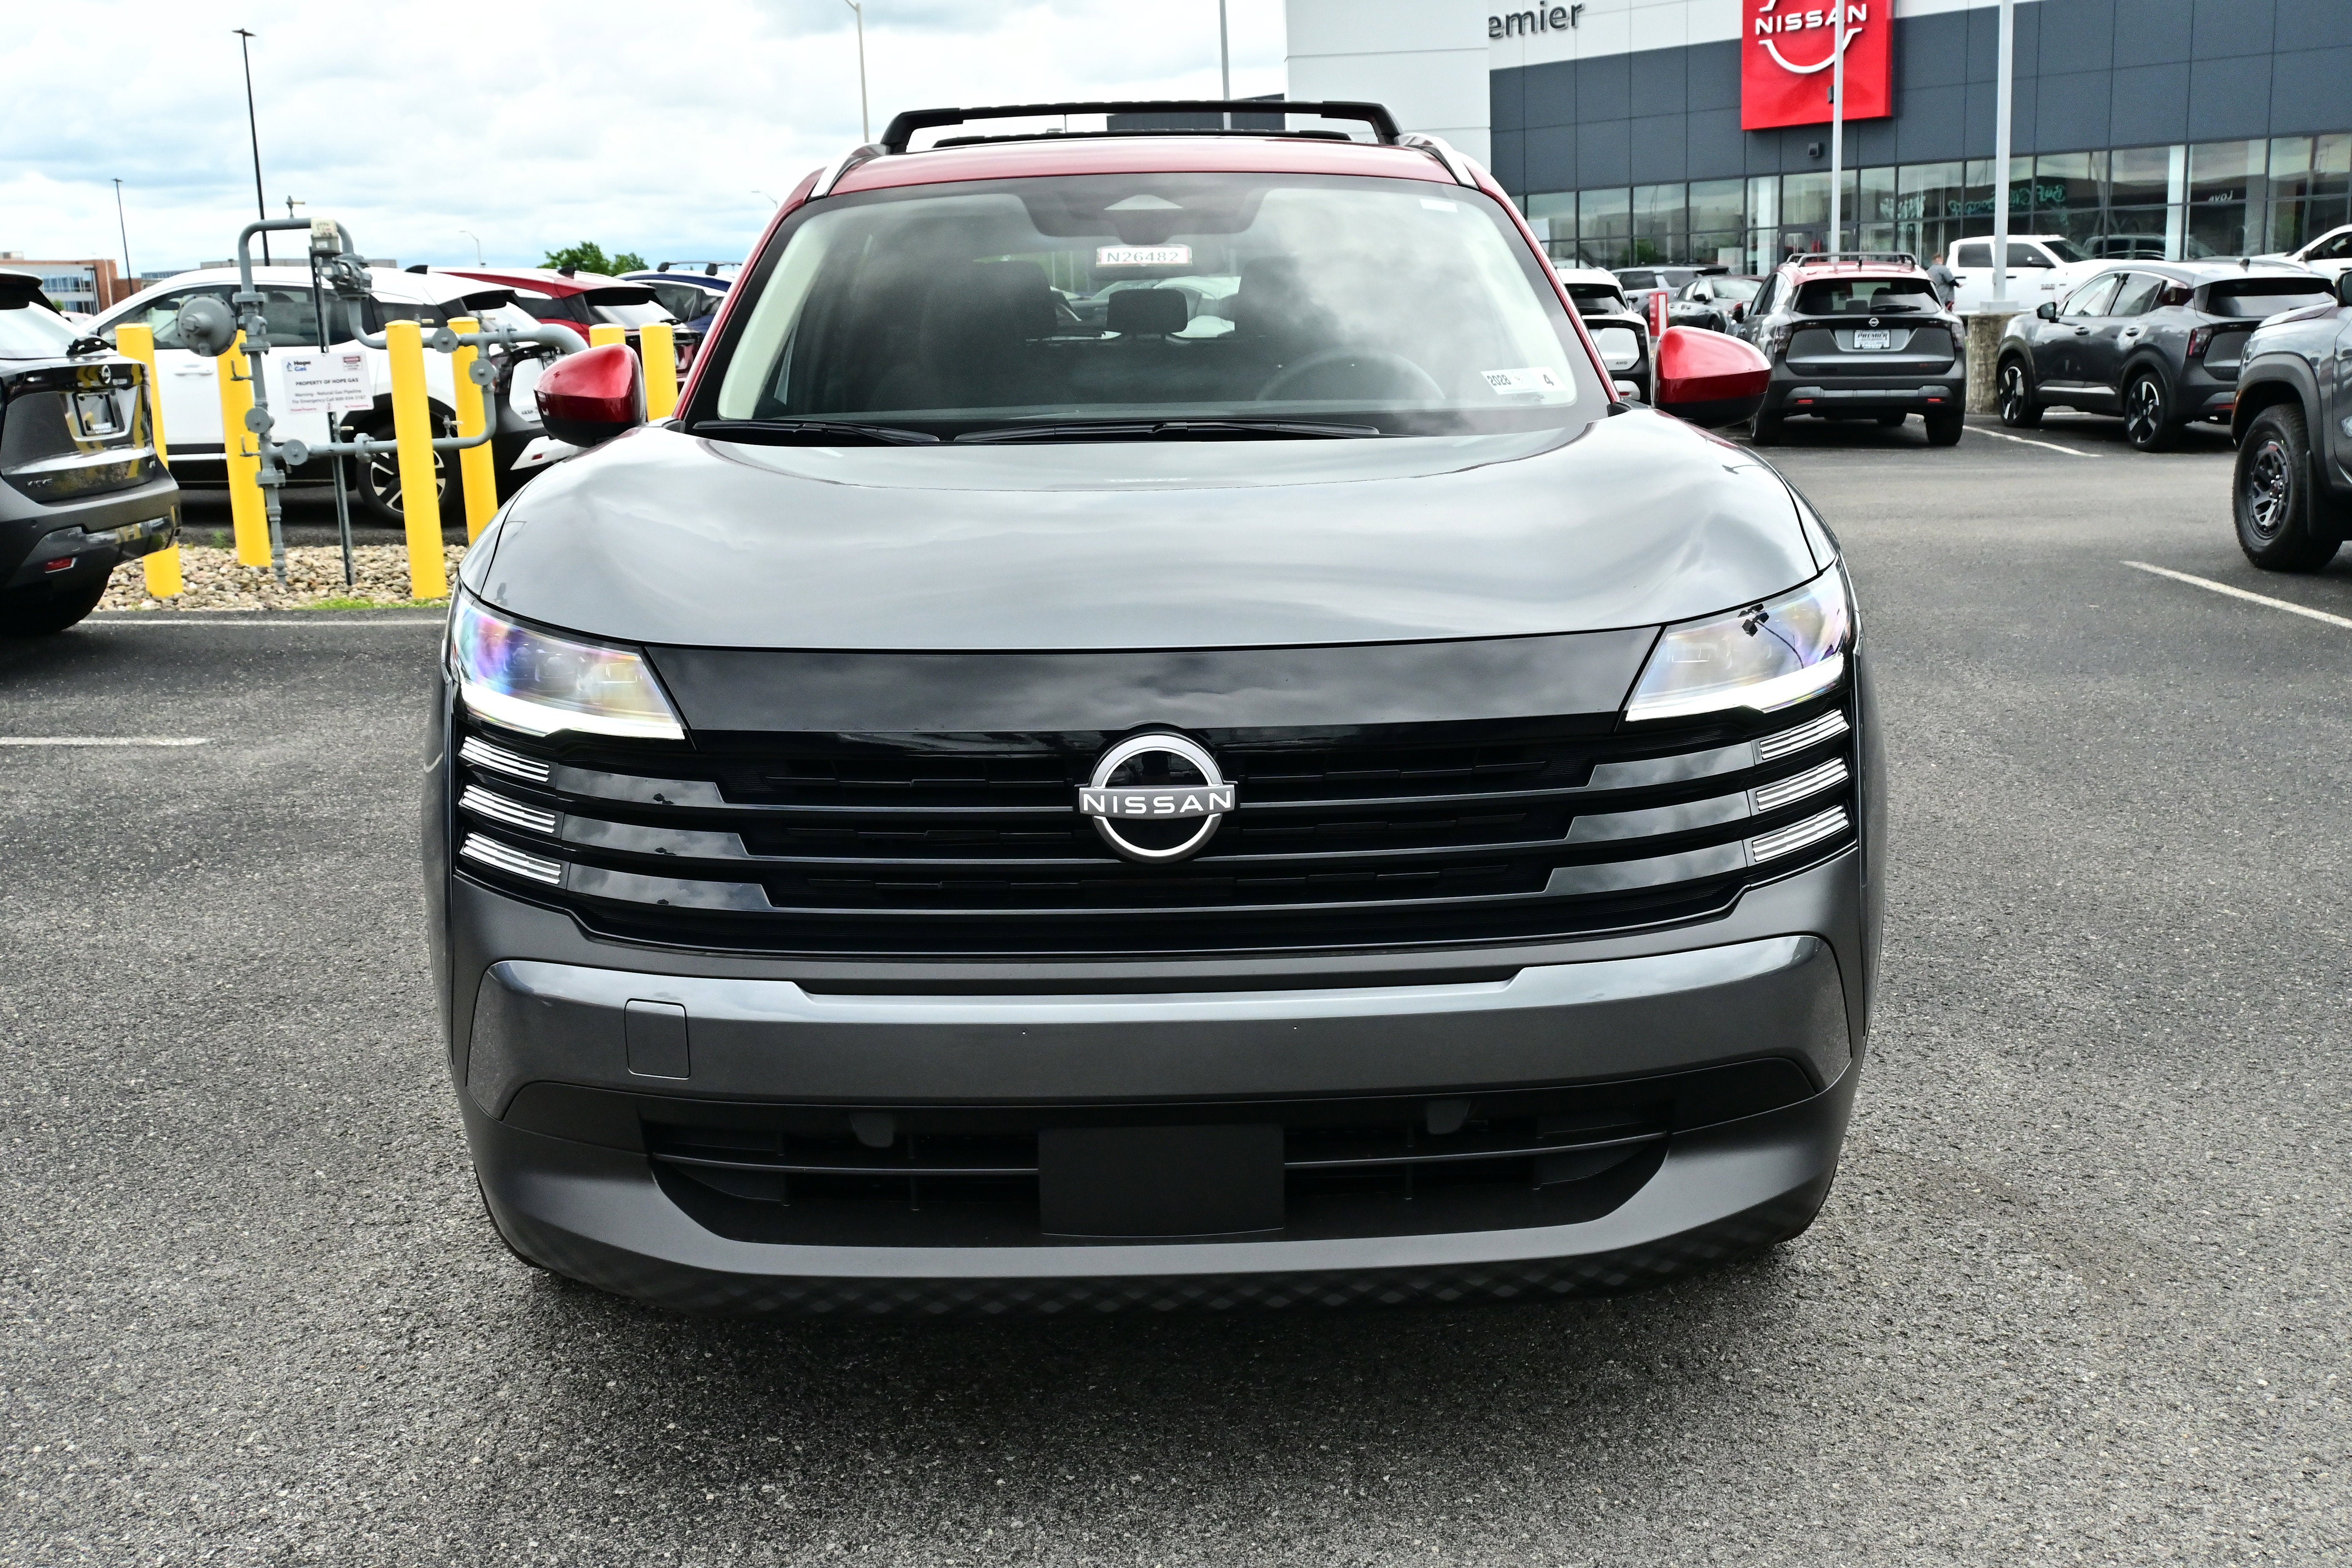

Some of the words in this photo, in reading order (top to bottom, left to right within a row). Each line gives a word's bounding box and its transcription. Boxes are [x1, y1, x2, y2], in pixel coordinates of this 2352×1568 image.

[1107, 251, 1179, 262] N26482
[1487, 374, 1511, 386] 2028
[1543, 374, 1554, 386] 4
[1083, 791, 1231, 814] NISSAN
